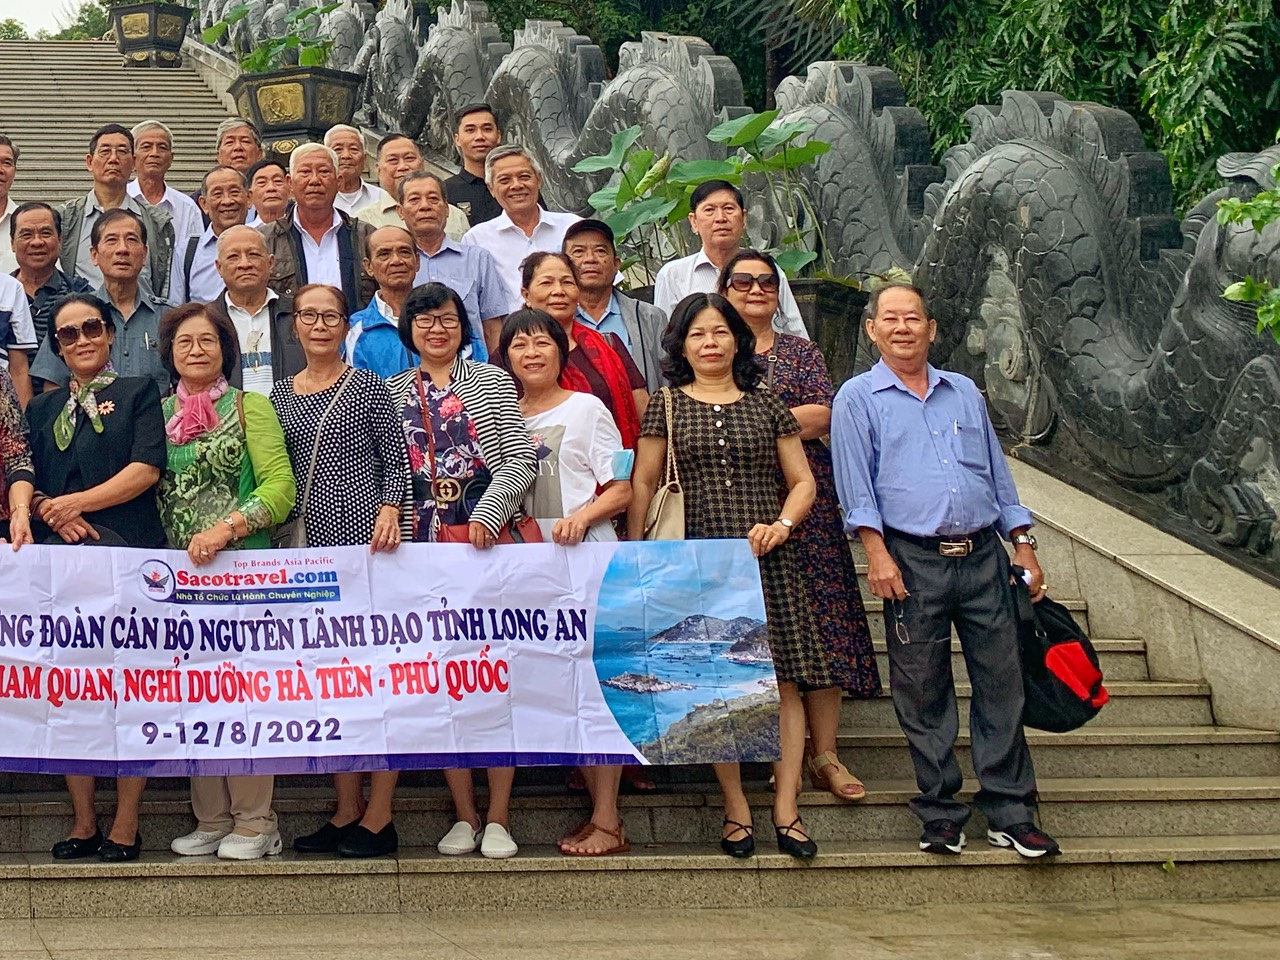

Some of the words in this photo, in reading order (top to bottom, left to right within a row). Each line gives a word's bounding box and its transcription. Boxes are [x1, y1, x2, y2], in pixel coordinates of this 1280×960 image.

[538, 460, 557, 476] TY
[233, 561, 248, 569] Top
[251, 559, 281, 567] Brands
[284, 558, 302, 566] Asia
[305, 556, 334, 565] Pacific
[176, 568, 338, 587] Sacotravel.com
[176, 592, 193, 600] Nhà
[194, 591, 204, 600] Tổ
[206, 592, 229, 601] Chức
[242, 592, 266, 600] Hành
[268, 590, 301, 600] Chuyên
[304, 589, 336, 599] Nghiệp
[39, 606, 106, 649] ĐOÀN
[110, 607, 159, 650] CÁN
[163, 609, 195, 661] BỘ
[199, 609, 294, 653] NGUYÊN
[300, 607, 367, 649] LÃNH
[370, 611, 423, 654] ĐẠO
[427, 596, 487, 642] TỈNH
[488, 608, 549, 642] LONG
[554, 608, 587, 642] AN
[47, 667, 118, 710] QUAN,
[123, 656, 182, 703] NGHỈ
[187, 661, 271, 704] DƯỠNG
[275, 659, 314, 702] HÀ
[316, 657, 372, 700] TIÊN
[388, 651, 440, 695] PHÚ
[445, 644, 510, 702] QUỐC
[141, 717, 342, 748] 9-12/8/2022
